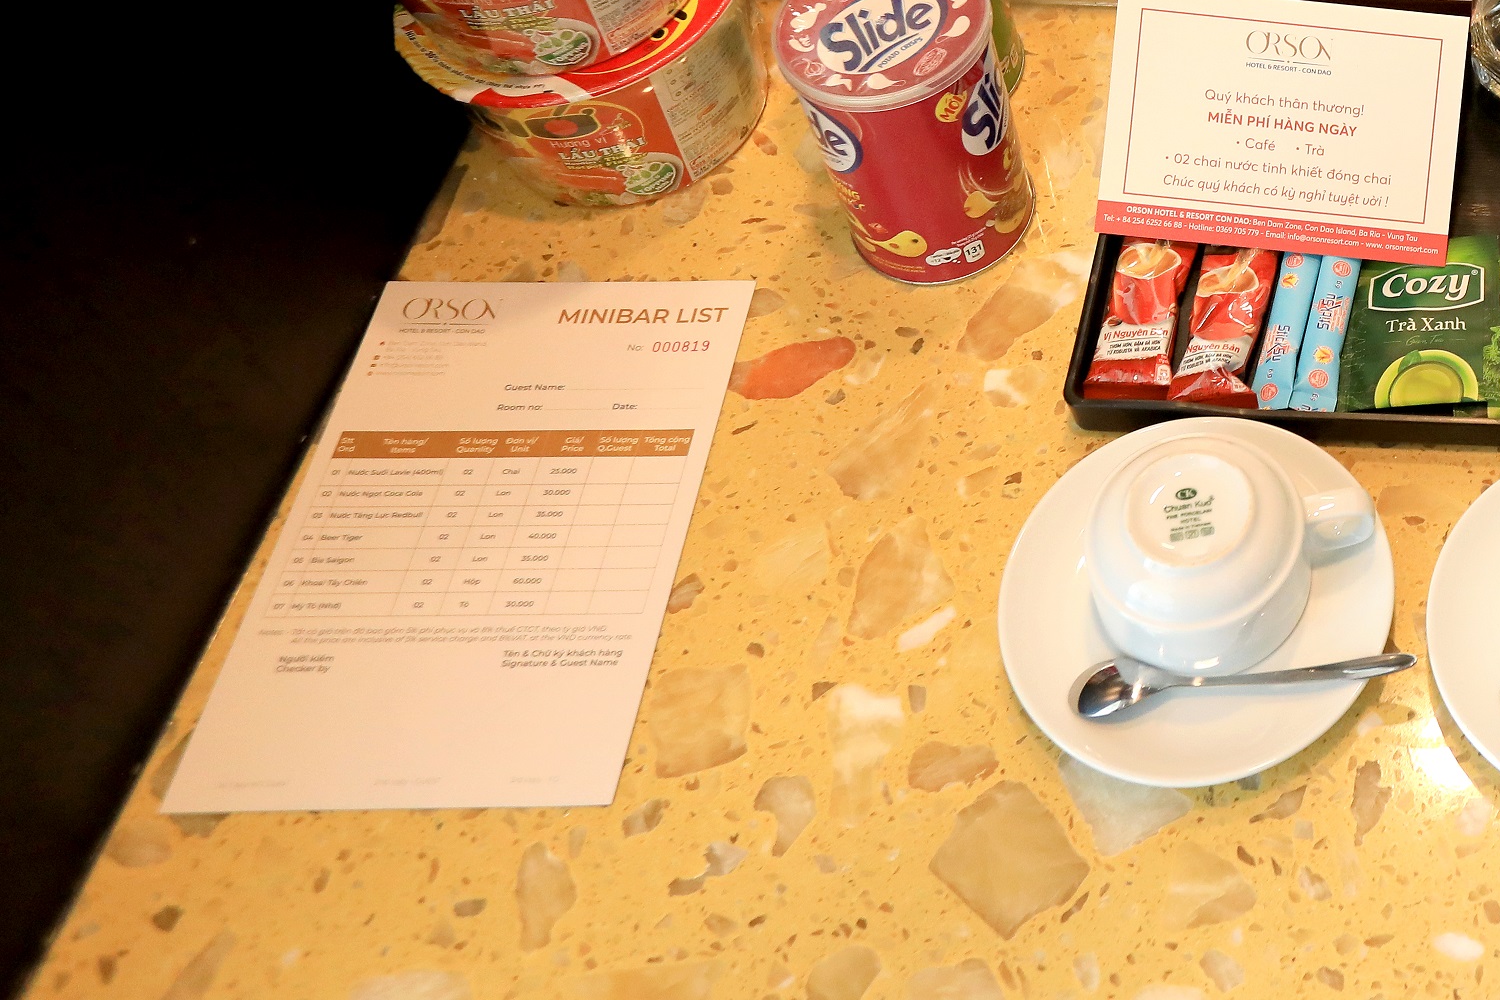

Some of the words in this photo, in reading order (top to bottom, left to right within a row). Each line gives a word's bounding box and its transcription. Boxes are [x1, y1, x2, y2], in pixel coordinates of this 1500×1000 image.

[877, 50, 900, 69] POTATO
[900, 37, 924, 53] CRISPS
[1245, 61, 1267, 70] HOTEL
[1272, 64, 1297, 73] RESORT
[1302, 67, 1316, 75] CON
[1315, 68, 1332, 76] DAO
[1204, 88, 1232, 105] Quý
[1235, 91, 1275, 107] khách
[1279, 96, 1310, 110] thân
[1312, 100, 1365, 118] thương!
[1208, 108, 1244, 127] MIỄN
[1247, 114, 1271, 129] PHÍ
[1274, 117, 1315, 134] HÀNG
[1318, 122, 1358, 137] NGÀY
[1245, 137, 1276, 151] Café
[1305, 143, 1325, 157] Trà
[1174, 153, 1190, 165] 02
[1193, 155, 1221, 168] chai
[1225, 158, 1259, 173] nước
[1262, 161, 1287, 175] tinh
[1291, 163, 1323, 179] khiết
[1326, 168, 1360, 185] đóng
[1364, 172, 1392, 186] chai
[1163, 173, 1195, 189] Chúc
[1197, 179, 1220, 193] quý
[1223, 180, 1261, 195] khách
[1263, 184, 1278, 197] có
[1281, 186, 1296, 201] kỳ
[1298, 188, 1326, 203] nghỉ
[1328, 192, 1359, 206] tuyệt
[1103, 213, 1115, 222] Tel:
[1145, 218, 1162, 227] 6252
[1163, 220, 1172, 228] 66
[1188, 223, 1215, 232] Hotline:
[1215, 225, 1233, 234] 0369
[1233, 227, 1247, 235] 705
[1247, 228, 1260, 237] 779
[1265, 230, 1286, 240] Email:
[1287, 233, 1360, 247] info@orsonresort.com
[1126, 205, 1153, 215] ORSON
[1154, 208, 1178, 218] HOTEL
[1185, 212, 1214, 221] RESORT
[1215, 215, 1233, 223] CON
[1233, 216, 1252, 225] DAO:
[1252, 218, 1266, 227] Ben
[1267, 220, 1284, 229] Dam
[1304, 223, 1319, 233] Con
[1320, 225, 1335, 234] Dao
[1359, 229, 1369, 237] Ba
[1370, 230, 1381, 239] Ria
[1387, 232, 1404, 242] Vung
[1406, 233, 1419, 242] Tau
[965, 243, 983, 256] 131
[1382, 272, 1470, 301] Cozy
[557, 308, 669, 325] MINIBAR
[675, 307, 729, 323] LIST
[1385, 318, 1417, 333] Trà
[1420, 317, 1467, 332] Xanh
[1113, 328, 1148, 341] Nguyên
[652, 340, 710, 353] 000819
[504, 383, 533, 392] Guest
[534, 383, 565, 391] Name:
[496, 403, 523, 412] Room
[612, 402, 638, 411] Date:
[654, 444, 676, 452] Total
